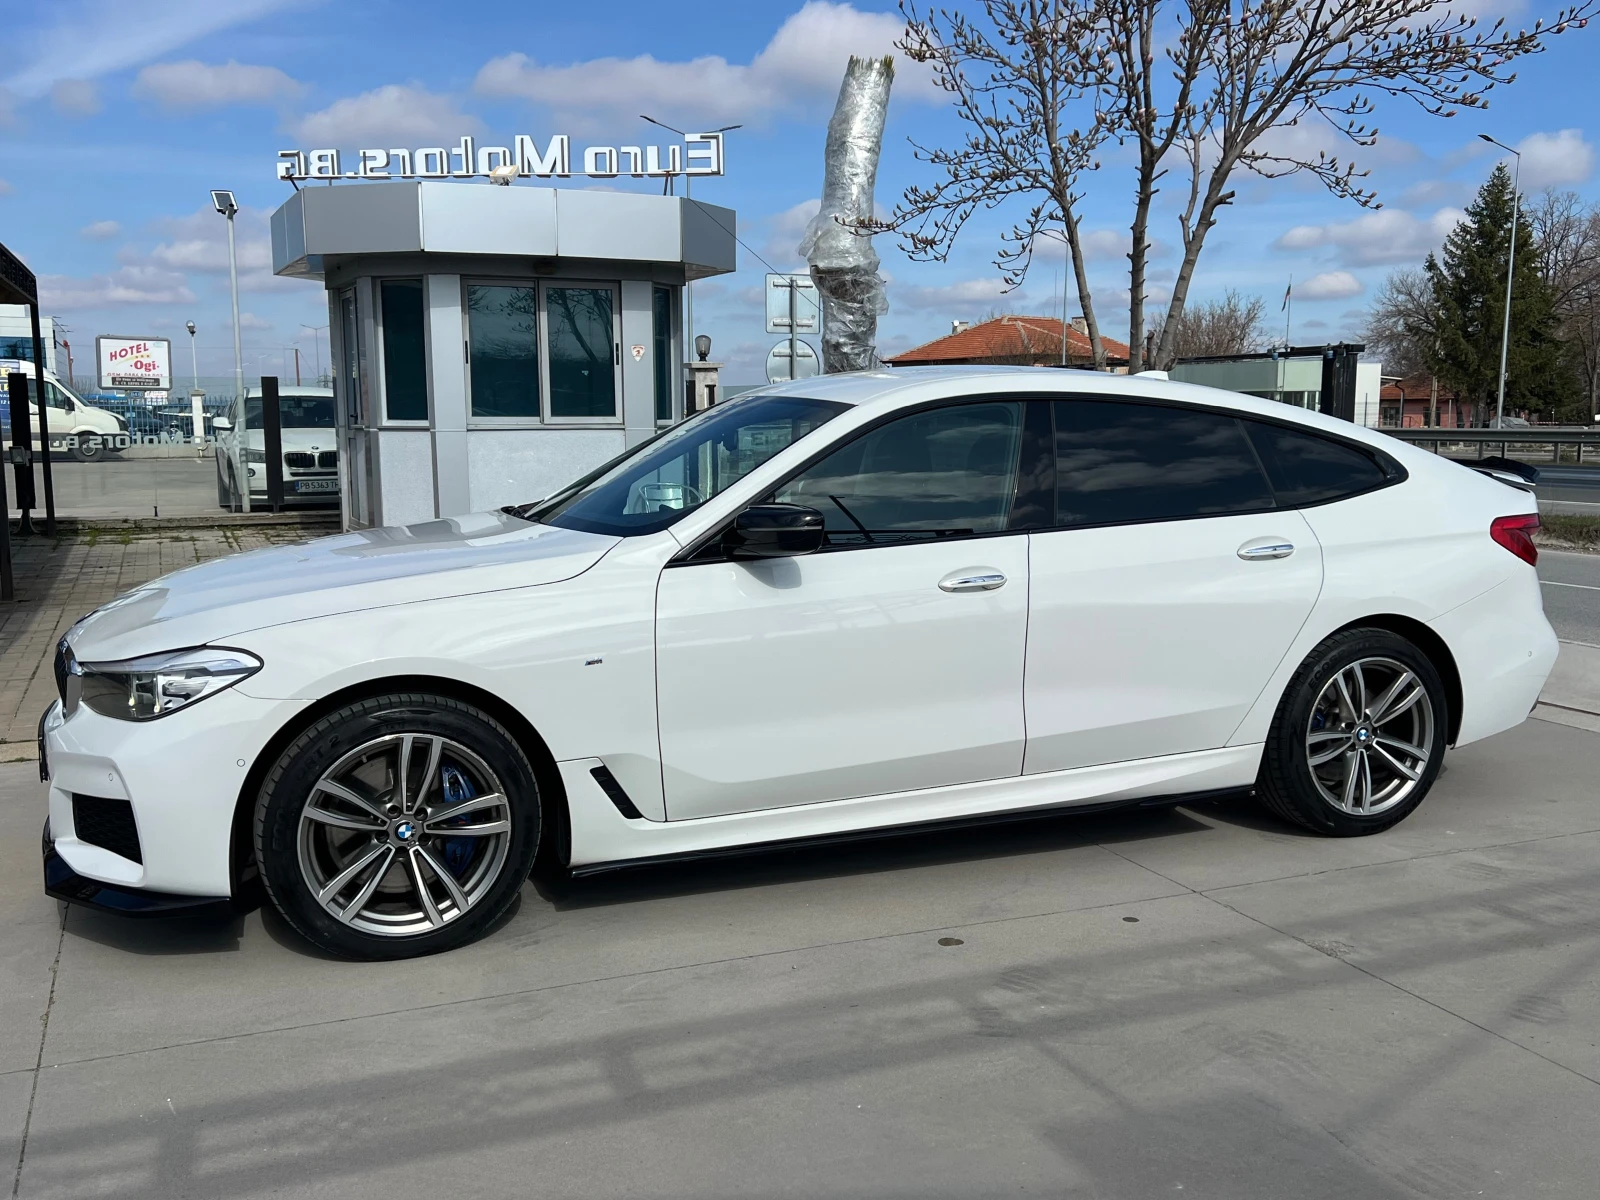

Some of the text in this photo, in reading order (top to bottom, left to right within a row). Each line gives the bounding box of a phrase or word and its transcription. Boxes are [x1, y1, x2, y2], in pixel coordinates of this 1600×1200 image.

[109, 342, 149, 361] HOTEL
[134, 360, 156, 372] Ogi
[300, 481, 310, 490] PB
[311, 481, 330, 490] 5363
